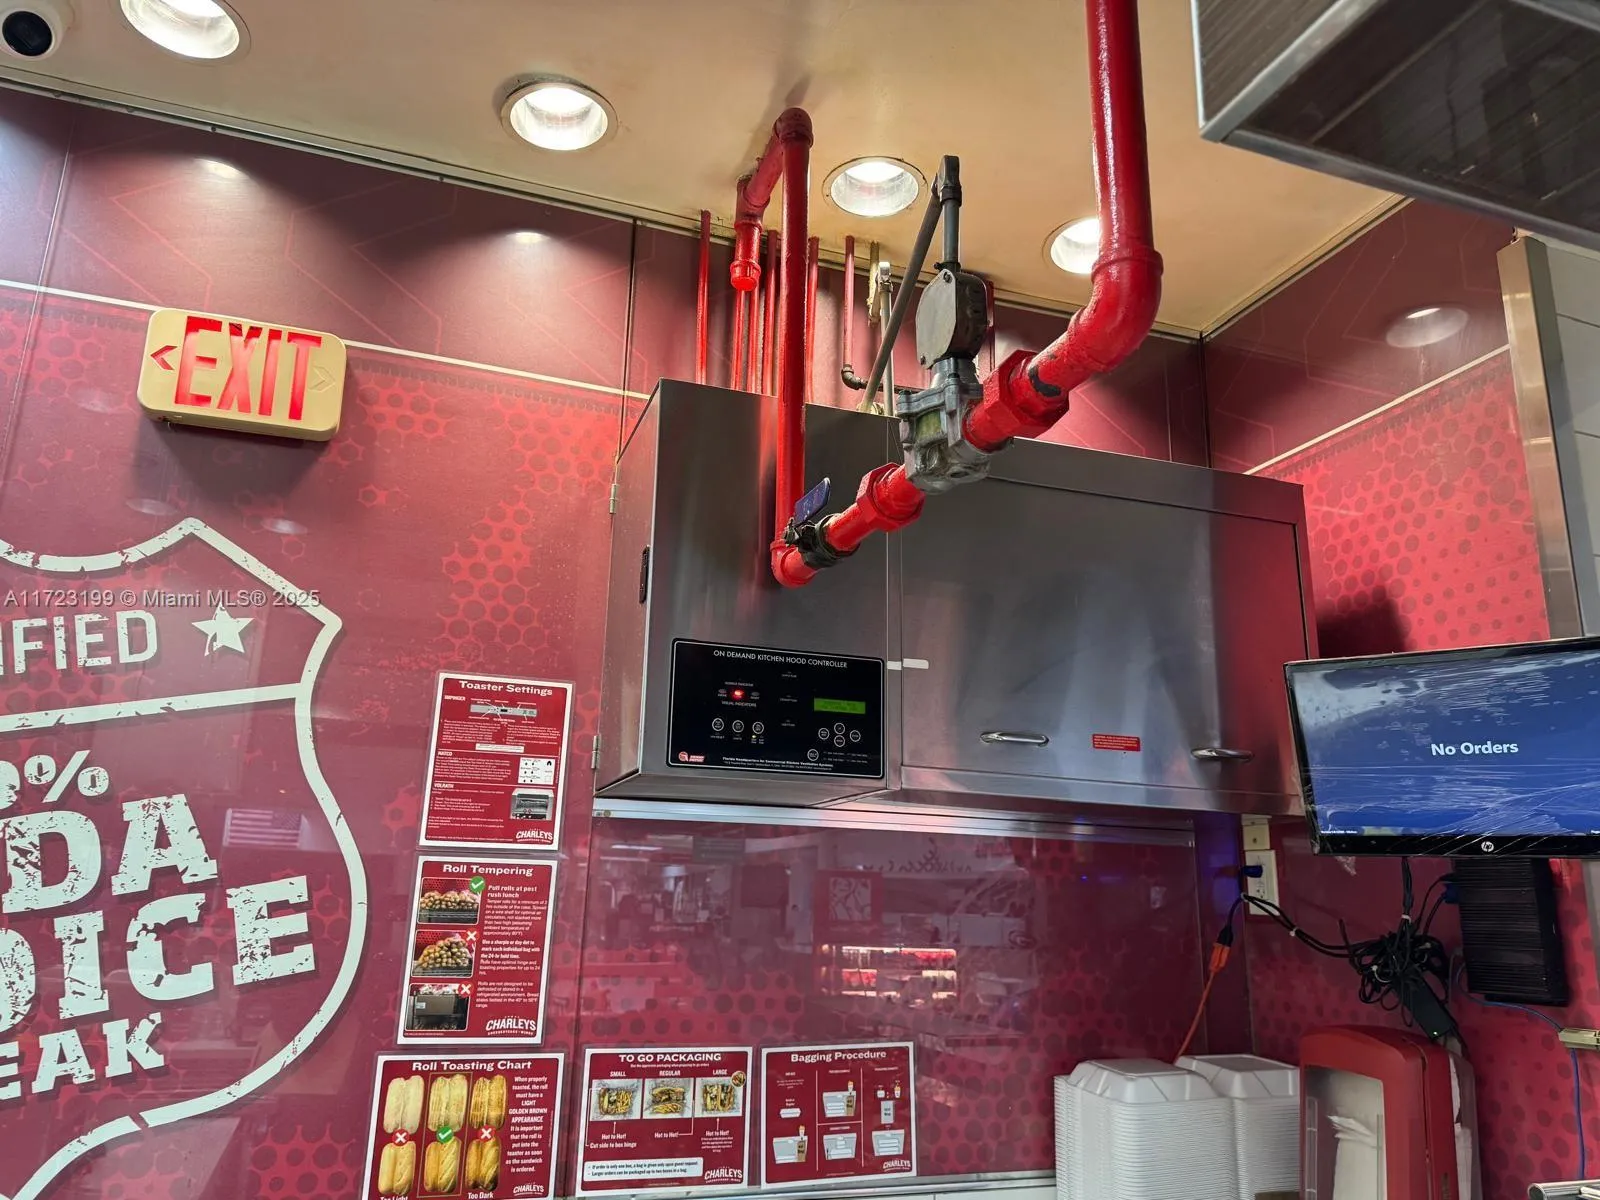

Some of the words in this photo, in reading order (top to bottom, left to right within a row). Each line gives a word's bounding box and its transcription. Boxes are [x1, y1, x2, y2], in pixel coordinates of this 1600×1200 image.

[174, 316, 322, 420] EXIT
[0, 610, 158, 674] FIED
[726, 651, 756, 659] DEMAND
[807, 659, 847, 668] CONTROLLER
[459, 680, 504, 692] Toaster
[506, 685, 552, 696] Settings
[1431, 743, 1456, 755] No
[1460, 741, 1518, 754] Orders
[516, 830, 552, 840] CHARLEYS
[442, 864, 466, 873] Roll
[470, 865, 534, 876] Tempering
[486, 1018, 536, 1030] CHARLEYS
[656, 1053, 721, 1061] PACKAGING
[791, 1053, 832, 1063] Bagging
[834, 1050, 886, 1060] Procedure
[412, 1062, 437, 1071] Roll
[441, 1061, 494, 1071] Toasting
[497, 1061, 532, 1069] Chart
[883, 1160, 911, 1169] CHARLEYS
[704, 1169, 743, 1179] CHARLEYS
[513, 1185, 544, 1193] CHARLEYS
